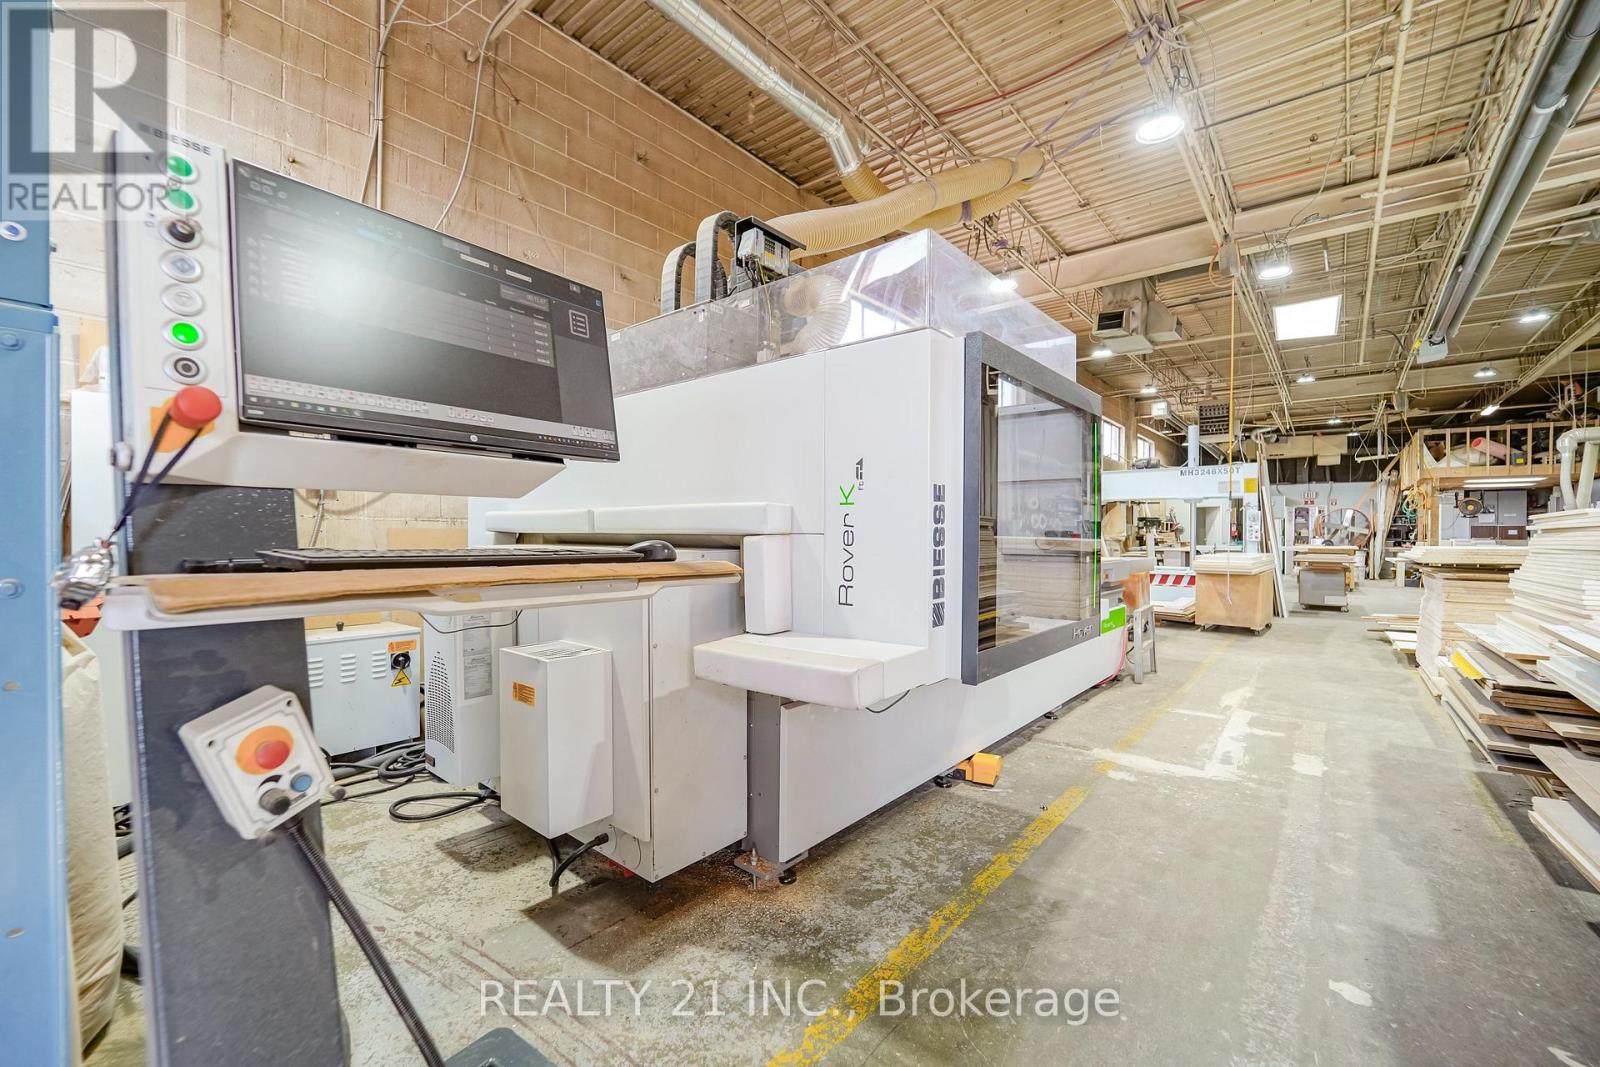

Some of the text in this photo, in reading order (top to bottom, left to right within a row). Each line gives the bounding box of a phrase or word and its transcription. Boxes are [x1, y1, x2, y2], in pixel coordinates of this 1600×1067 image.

[152, 127, 211, 156] BIESSE
[838, 484, 855, 607] Rover K
[932, 484, 945, 600] BIESSE
